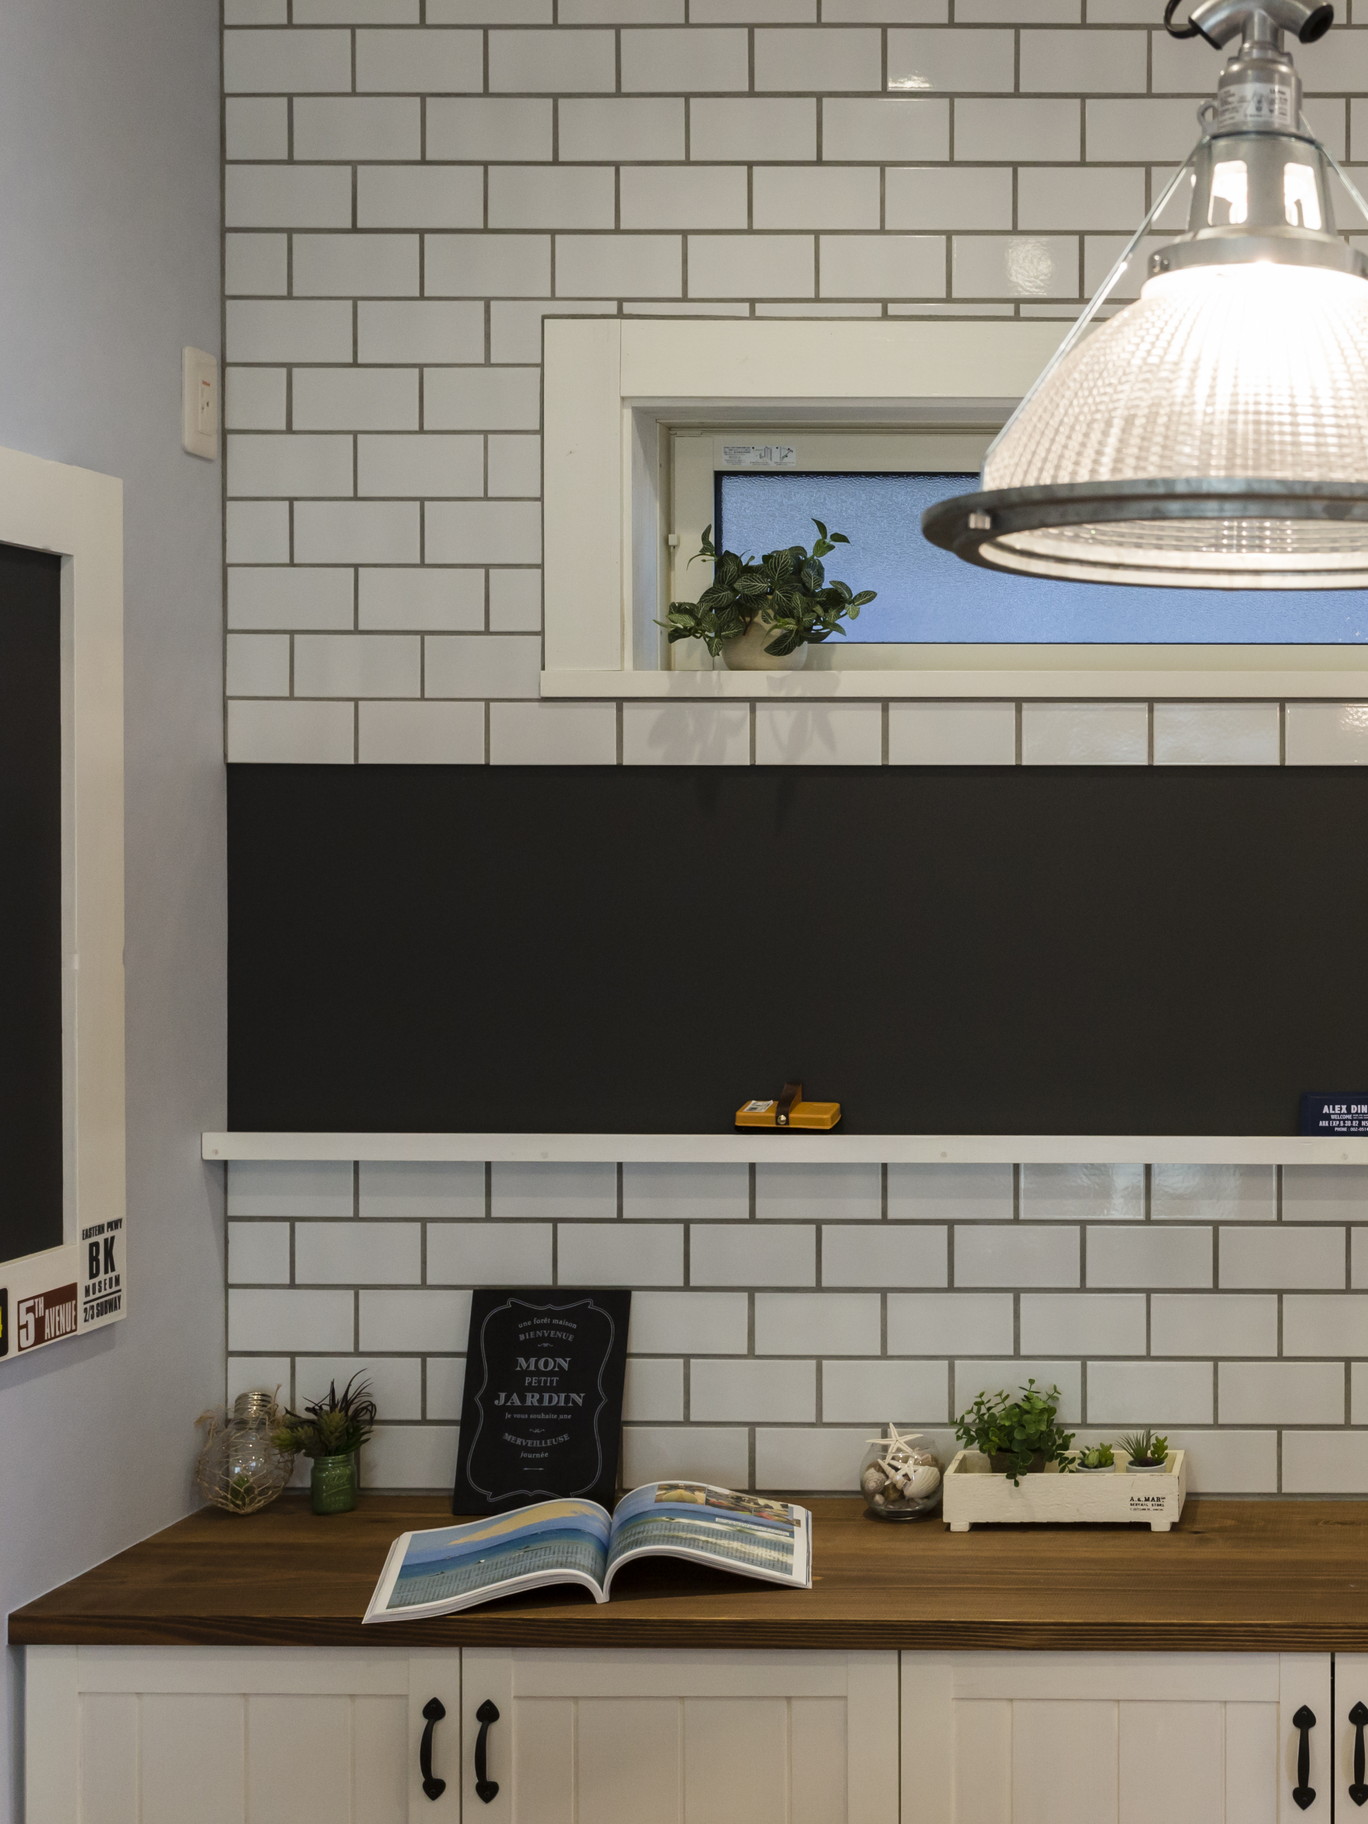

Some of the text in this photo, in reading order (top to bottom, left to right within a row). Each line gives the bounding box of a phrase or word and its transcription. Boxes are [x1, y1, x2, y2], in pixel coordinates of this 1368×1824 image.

[1322, 1104, 1347, 1114] ALEX
[82, 1218, 123, 1240] EASTERN PKWY
[88, 1235, 116, 1280] BK
[84, 1274, 120, 1298] MUSEUM
[83, 1295, 122, 1323] 2/3 SUBWAY
[45, 1300, 76, 1340] AVENUE
[518, 1330, 575, 1342] BIENVENUE
[515, 1357, 572, 1372] MON
[525, 1377, 559, 1386] PETIT
[494, 1392, 586, 1407] JARDIN
[502, 1432, 570, 1447] MERVEILLEUSE
